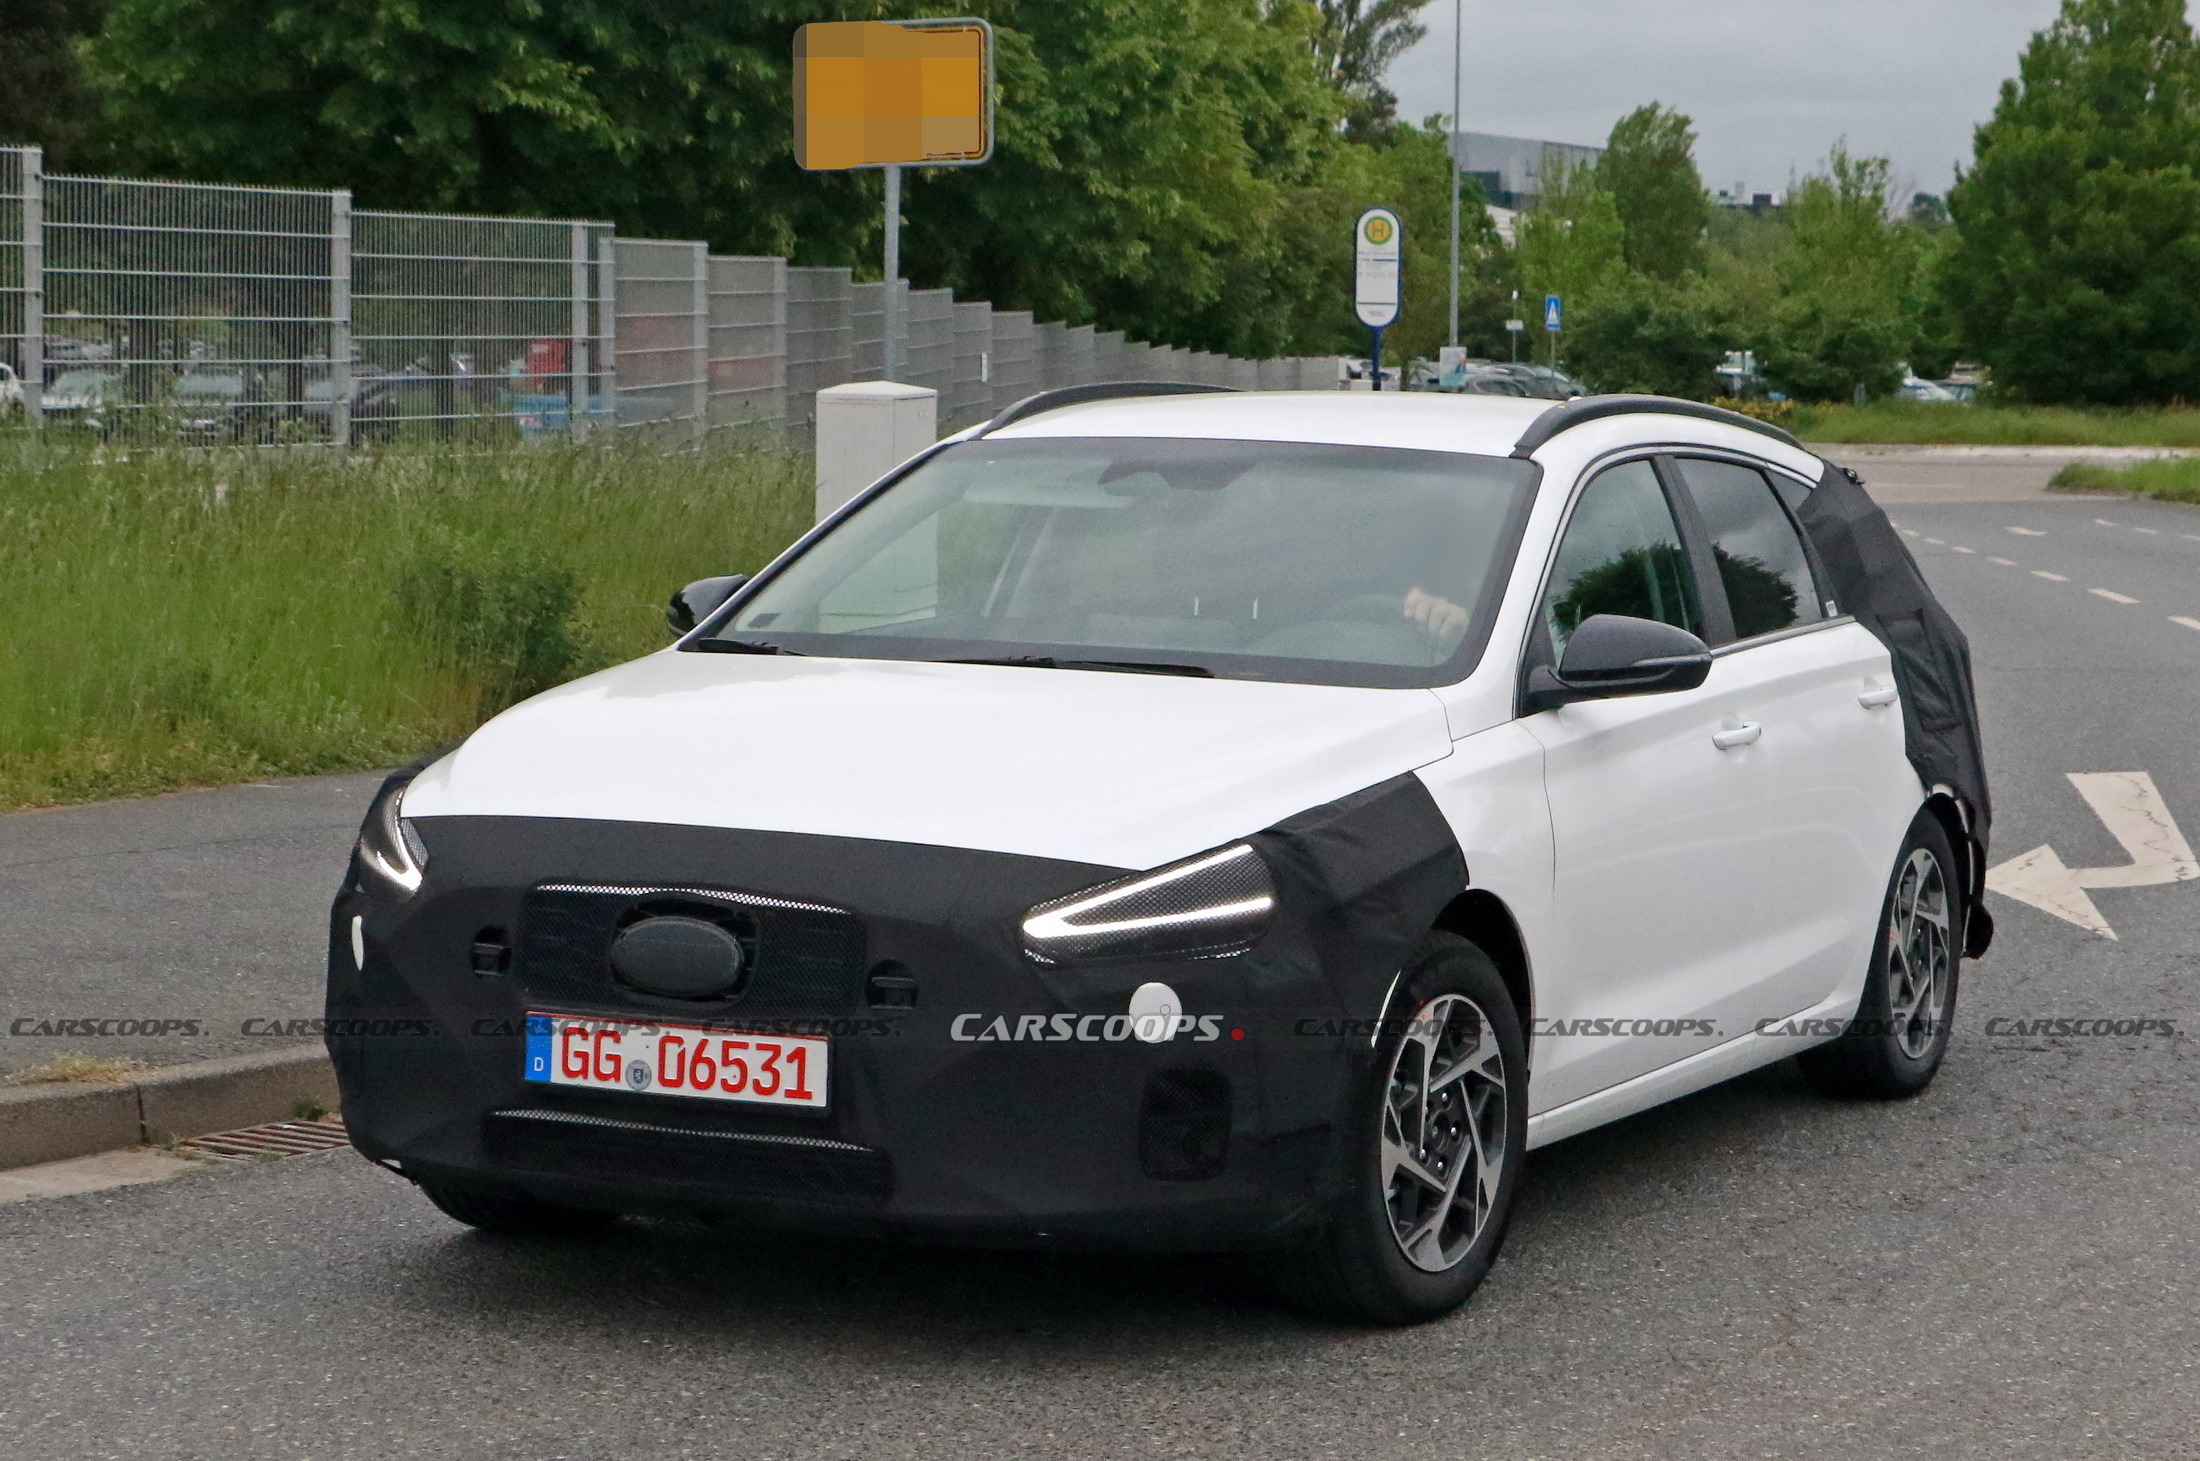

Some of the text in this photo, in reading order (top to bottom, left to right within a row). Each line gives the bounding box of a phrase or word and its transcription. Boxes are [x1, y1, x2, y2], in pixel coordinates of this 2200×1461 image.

[1371, 222, 1385, 238] H
[534, 1057, 544, 1071] D
[561, 1026, 813, 1101] GG 06531
